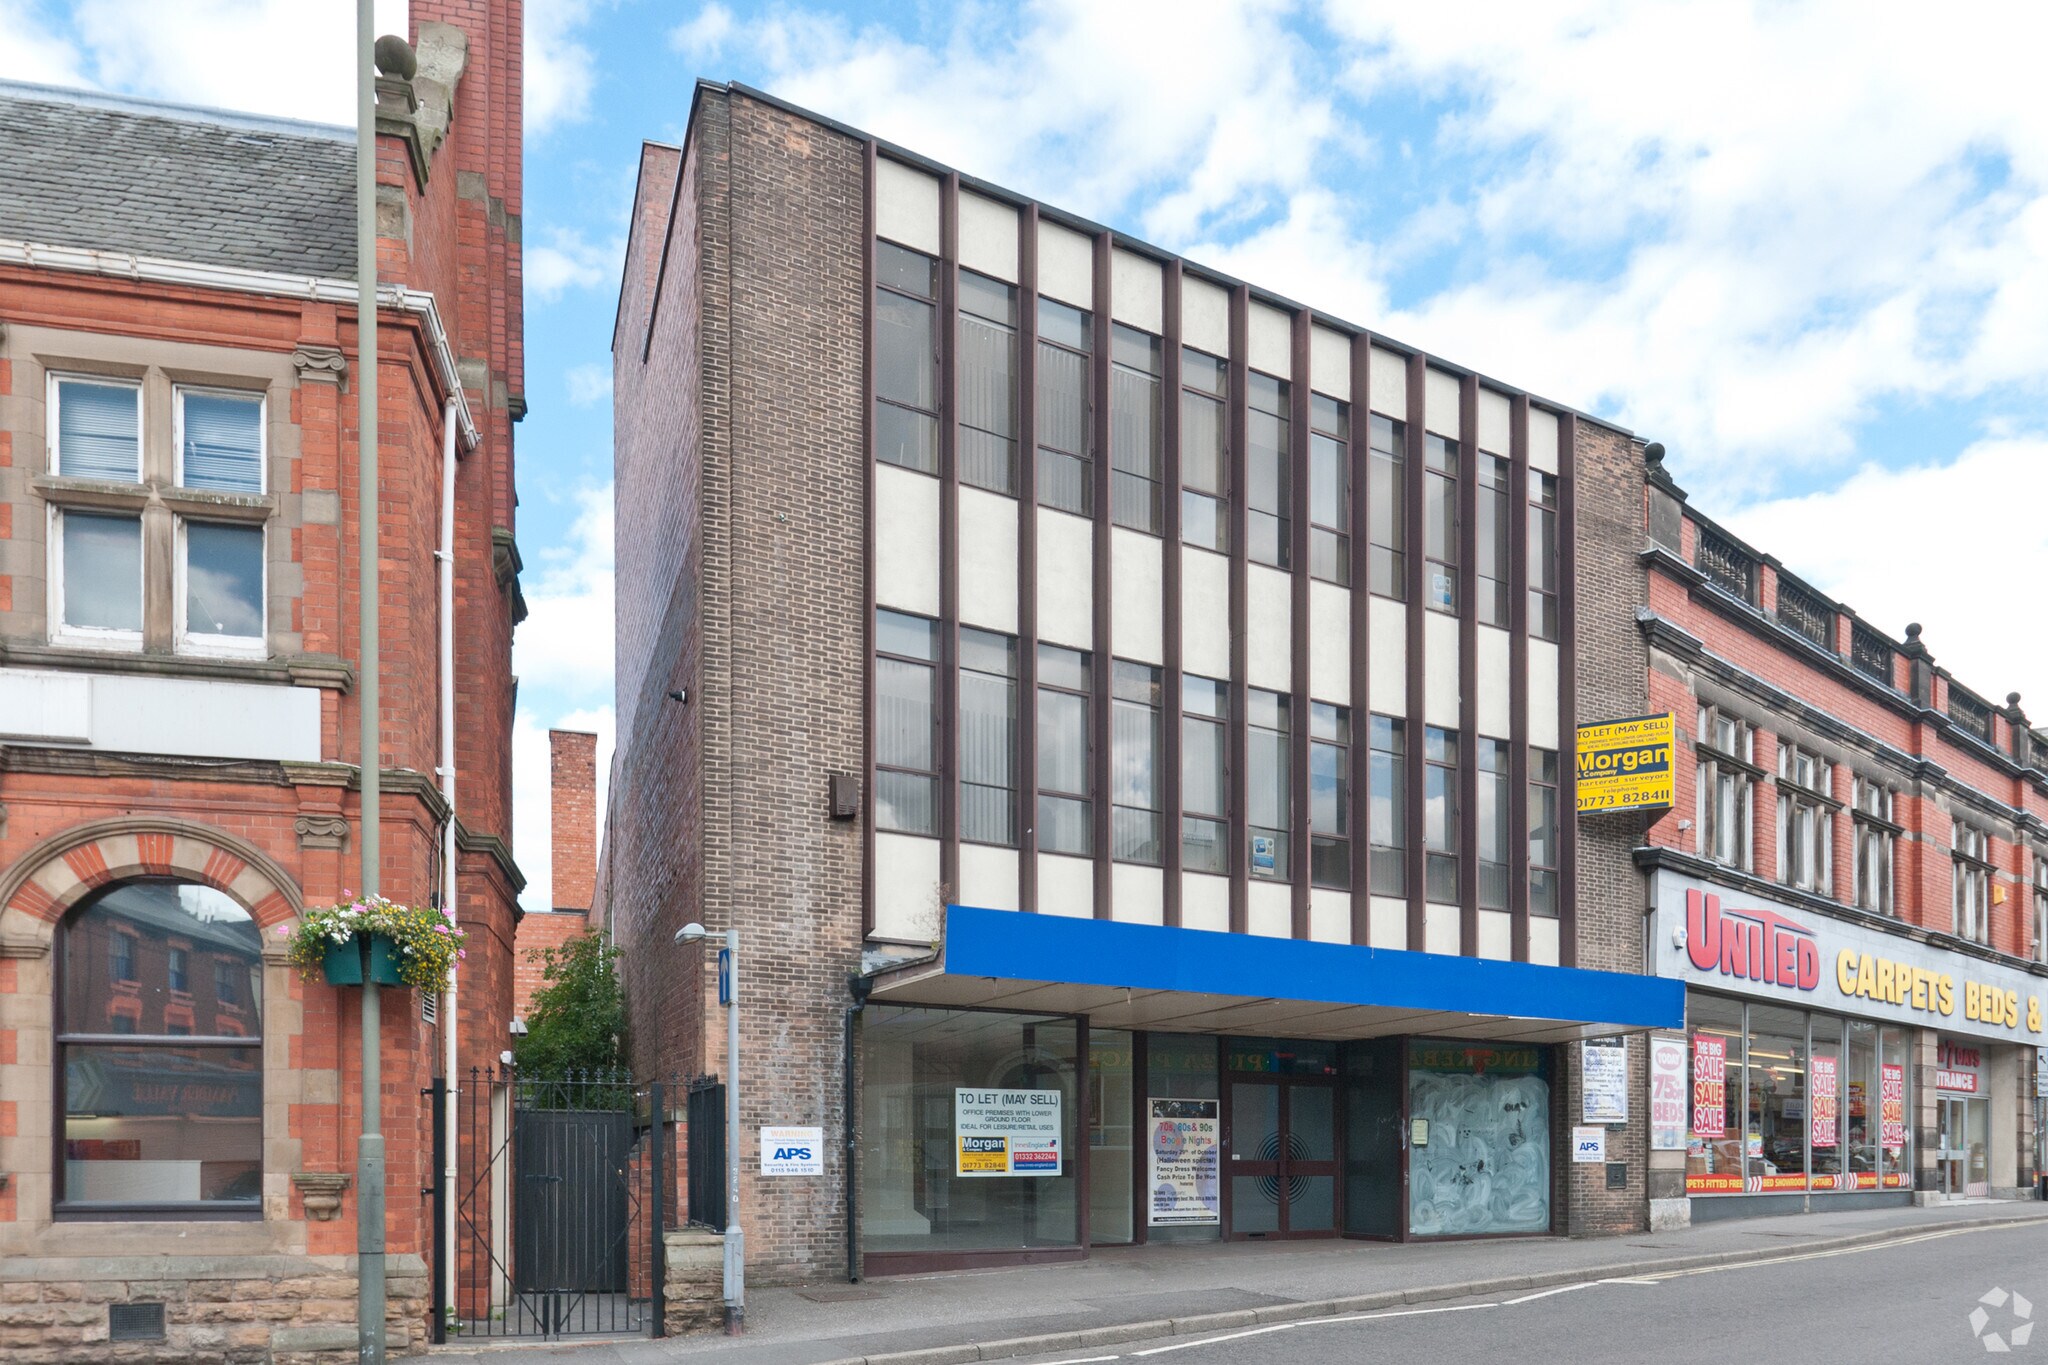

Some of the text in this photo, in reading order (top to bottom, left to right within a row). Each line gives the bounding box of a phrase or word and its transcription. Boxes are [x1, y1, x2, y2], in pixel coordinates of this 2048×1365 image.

[1577, 720, 1669, 739] TO LET (MAY SELL)
[1577, 747, 1669, 772] Morgan
[1578, 773, 1669, 787] hartered surveyors
[1583, 769, 1618, 778] Company
[1577, 790, 1669, 808] 01773 828411
[1686, 887, 2043, 1034] UNITED CARPETS BEDS &
[1696, 1041, 1722, 1055] THE BIG
[1946, 1040, 1955, 1069] 7
[1657, 1053, 1680, 1065] TODAY
[1814, 1062, 1834, 1073] THE BIG
[1694, 1055, 1724, 1083] SALE
[1694, 1080, 1724, 1108] SALE
[1813, 1074, 1836, 1097] SALE
[1882, 1080, 1902, 1101] SALE
[960, 1094, 1058, 1107] TO LET (MAY SELL)
[1813, 1097, 1836, 1120] SALE
[1653, 1102, 1684, 1122] BEDS
[1694, 1106, 1724, 1133] SALE
[1882, 1100, 1902, 1122] SALE
[1200, 1123, 1213, 1132] 90s
[1812, 1119, 1836, 1142] SALE
[1882, 1122, 1903, 1144] SALE
[962, 1137, 1005, 1151] Morgan
[1161, 1135, 1211, 1146] Boogie Nights
[1580, 1142, 1598, 1151] APS
[774, 1148, 812, 1160] APS
[1706, 1179, 1727, 1188] FITTED
[1729, 1179, 1743, 1188] FREE
[1762, 1178, 1774, 1187] BED
